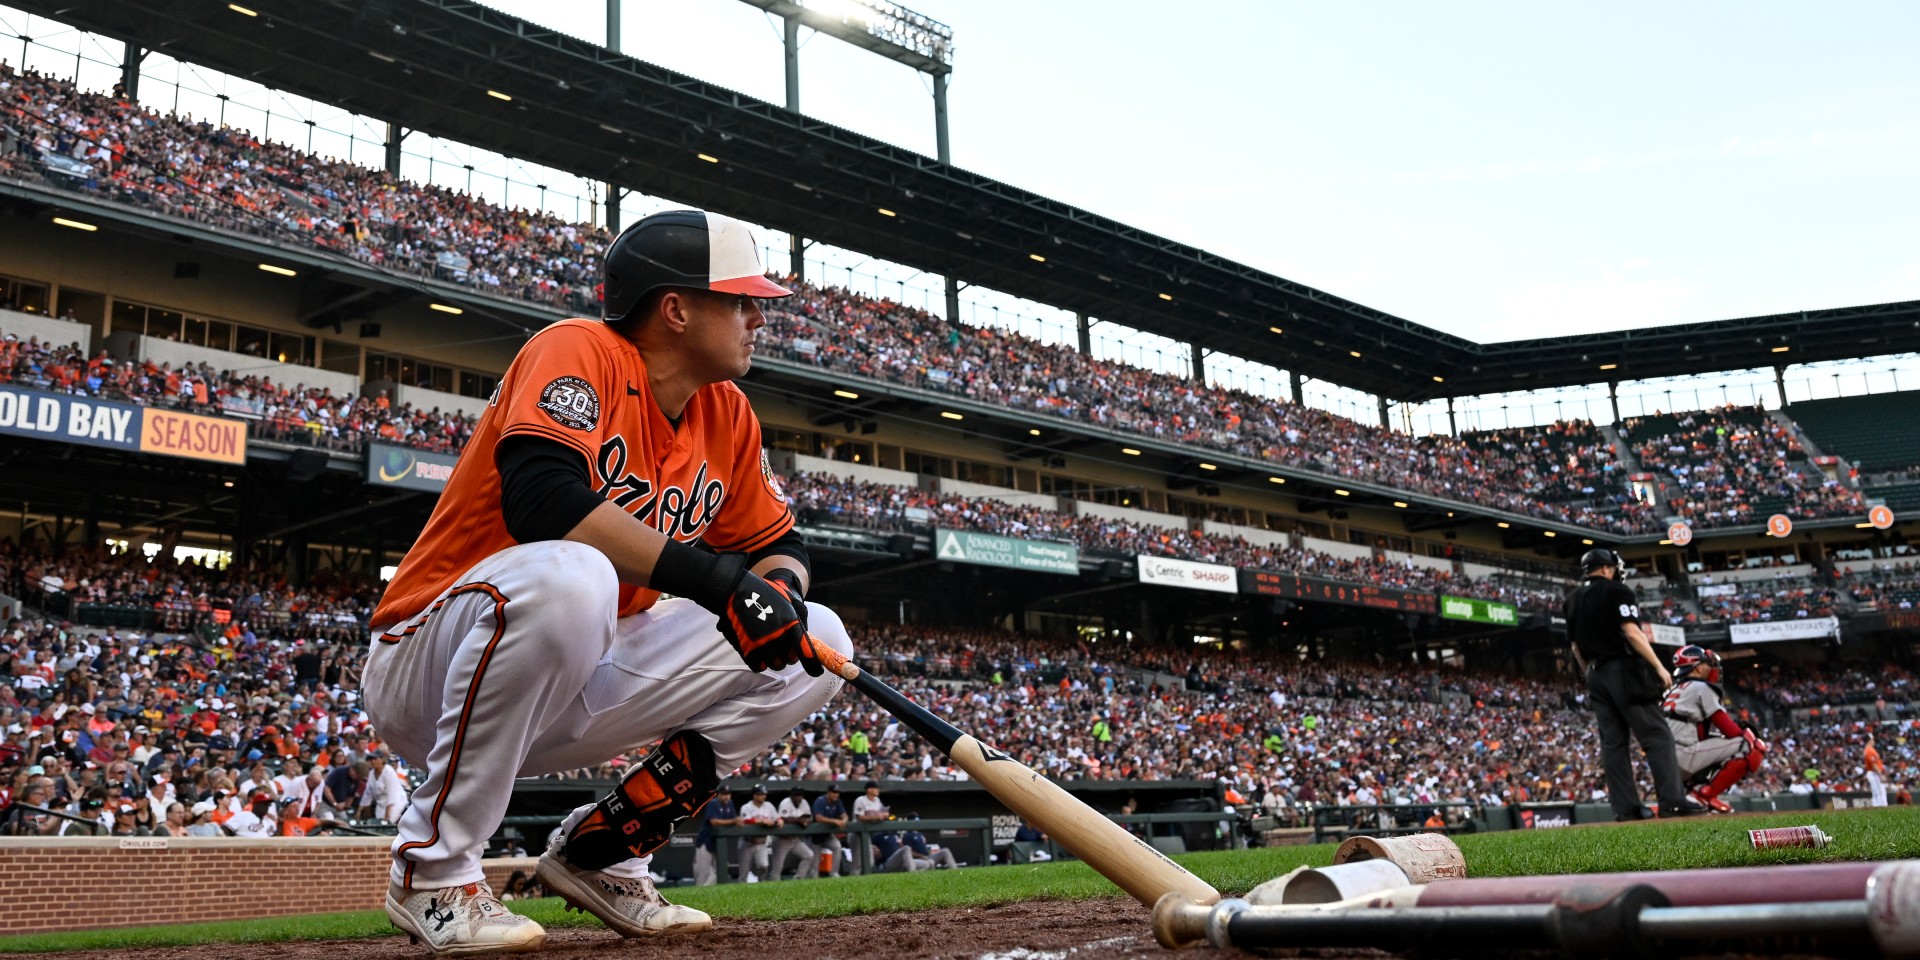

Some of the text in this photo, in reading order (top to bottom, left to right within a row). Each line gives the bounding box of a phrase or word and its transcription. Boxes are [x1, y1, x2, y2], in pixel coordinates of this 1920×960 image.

[556, 385, 589, 413] 30
[537, 402, 597, 431] Anniversary
[150, 415, 238, 457] SEASON
[1877, 510, 1886, 523] 4
[1775, 518, 1786, 533] 5
[1672, 527, 1690, 541] 20
[1192, 569, 1230, 583] SHARP
[673, 779, 693, 794] 6
[622, 819, 641, 835] 6
[992, 815, 1022, 827] ROYAL
